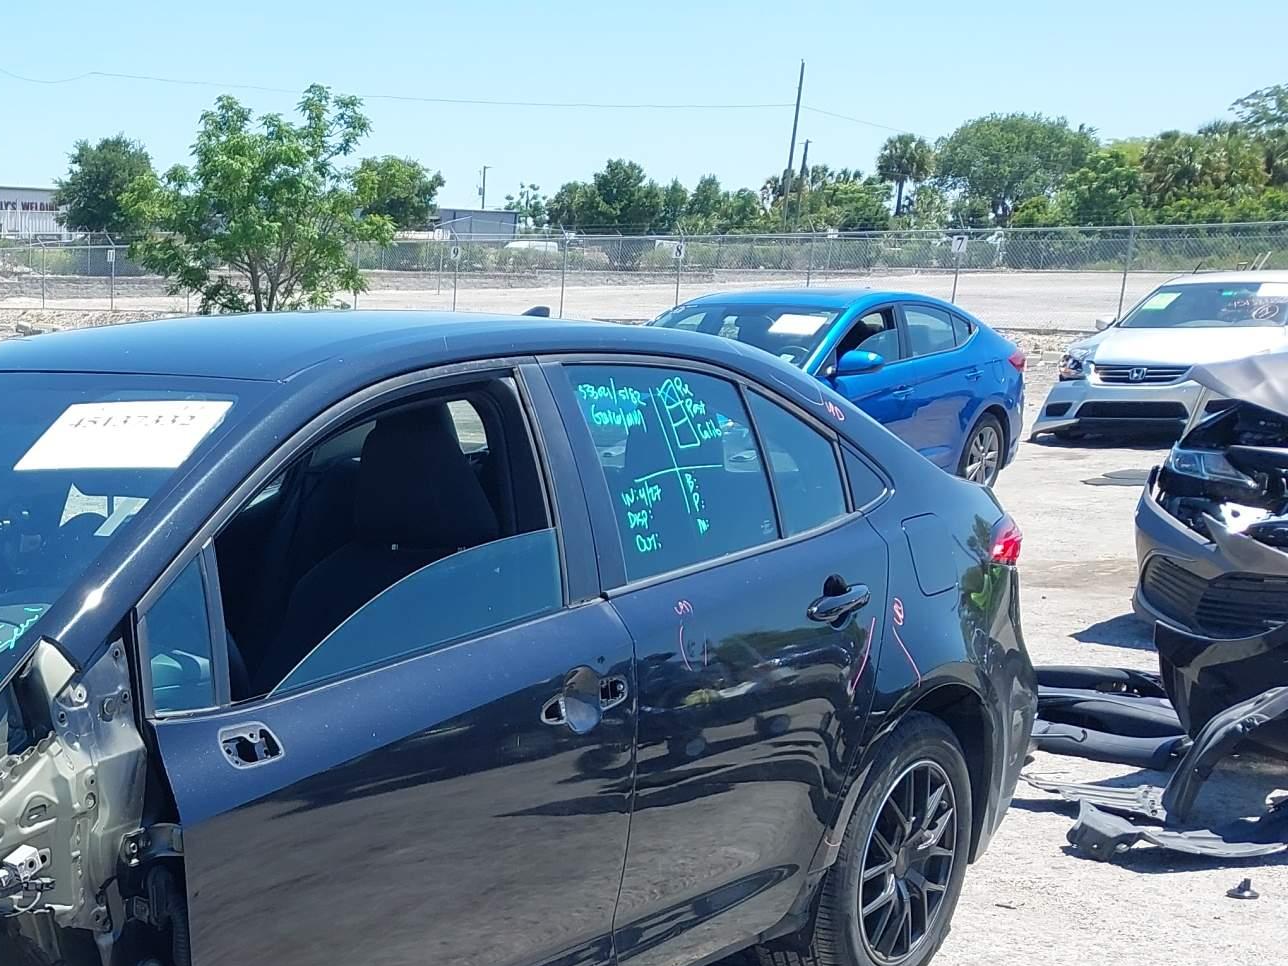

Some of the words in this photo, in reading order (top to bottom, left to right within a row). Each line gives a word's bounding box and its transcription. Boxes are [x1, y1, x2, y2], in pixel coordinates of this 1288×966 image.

[956, 236, 964, 251] 7
[452, 247, 459, 258] 9
[675, 244, 683, 257] 8
